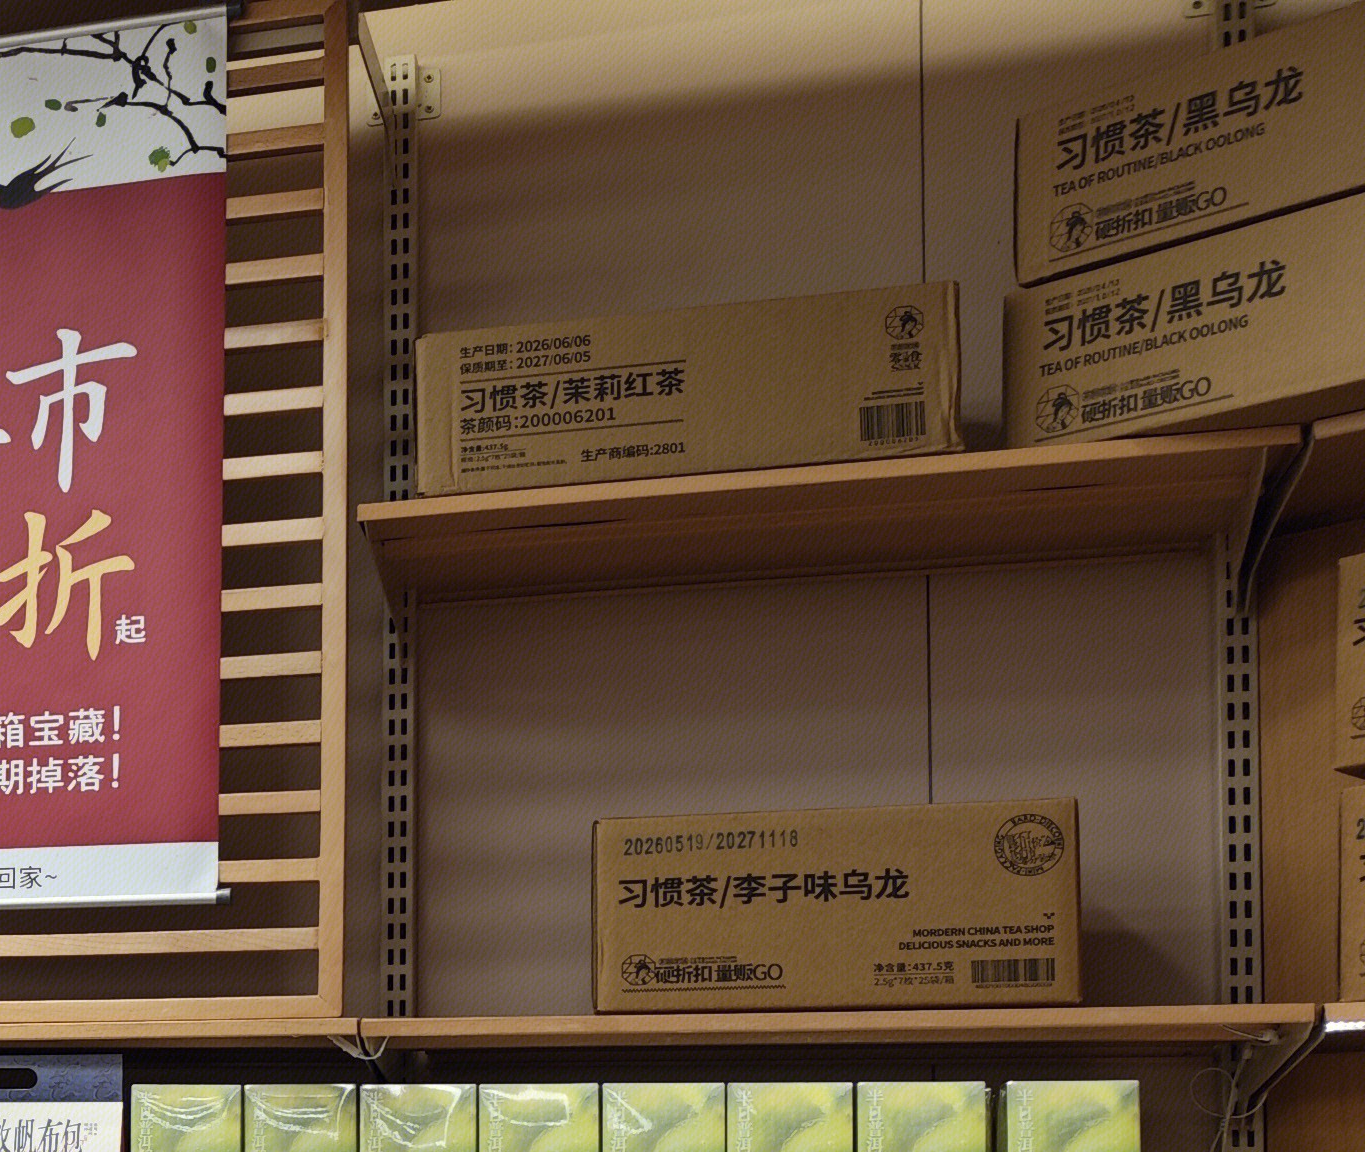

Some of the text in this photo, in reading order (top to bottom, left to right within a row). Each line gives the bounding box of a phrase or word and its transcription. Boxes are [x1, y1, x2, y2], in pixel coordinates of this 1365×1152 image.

[1055, 66, 1304, 172] 习惯茶/黑乌龙
[1053, 179, 1076, 197] TEA
[1077, 174, 1096, 191] OF
[1204, 122, 1266, 152] OOLONG
[1042, 259, 1287, 354] 习惯茶/黑乌龙
[1039, 360, 1064, 379] TEA
[1064, 354, 1083, 371] OF
[1188, 312, 1249, 341] OOLONG
[459, 367, 685, 414] 习惯茶/茉莉红茶
[623, 828, 798, 856] 20260519/20271118
[617, 868, 909, 909] 习惯茶/李子味乌龙
[898, 937, 1055, 950] DELICIOUS SNACKS AND MORE
[912, 924, 1054, 938] MORDERN CHINA TEA SHOP
